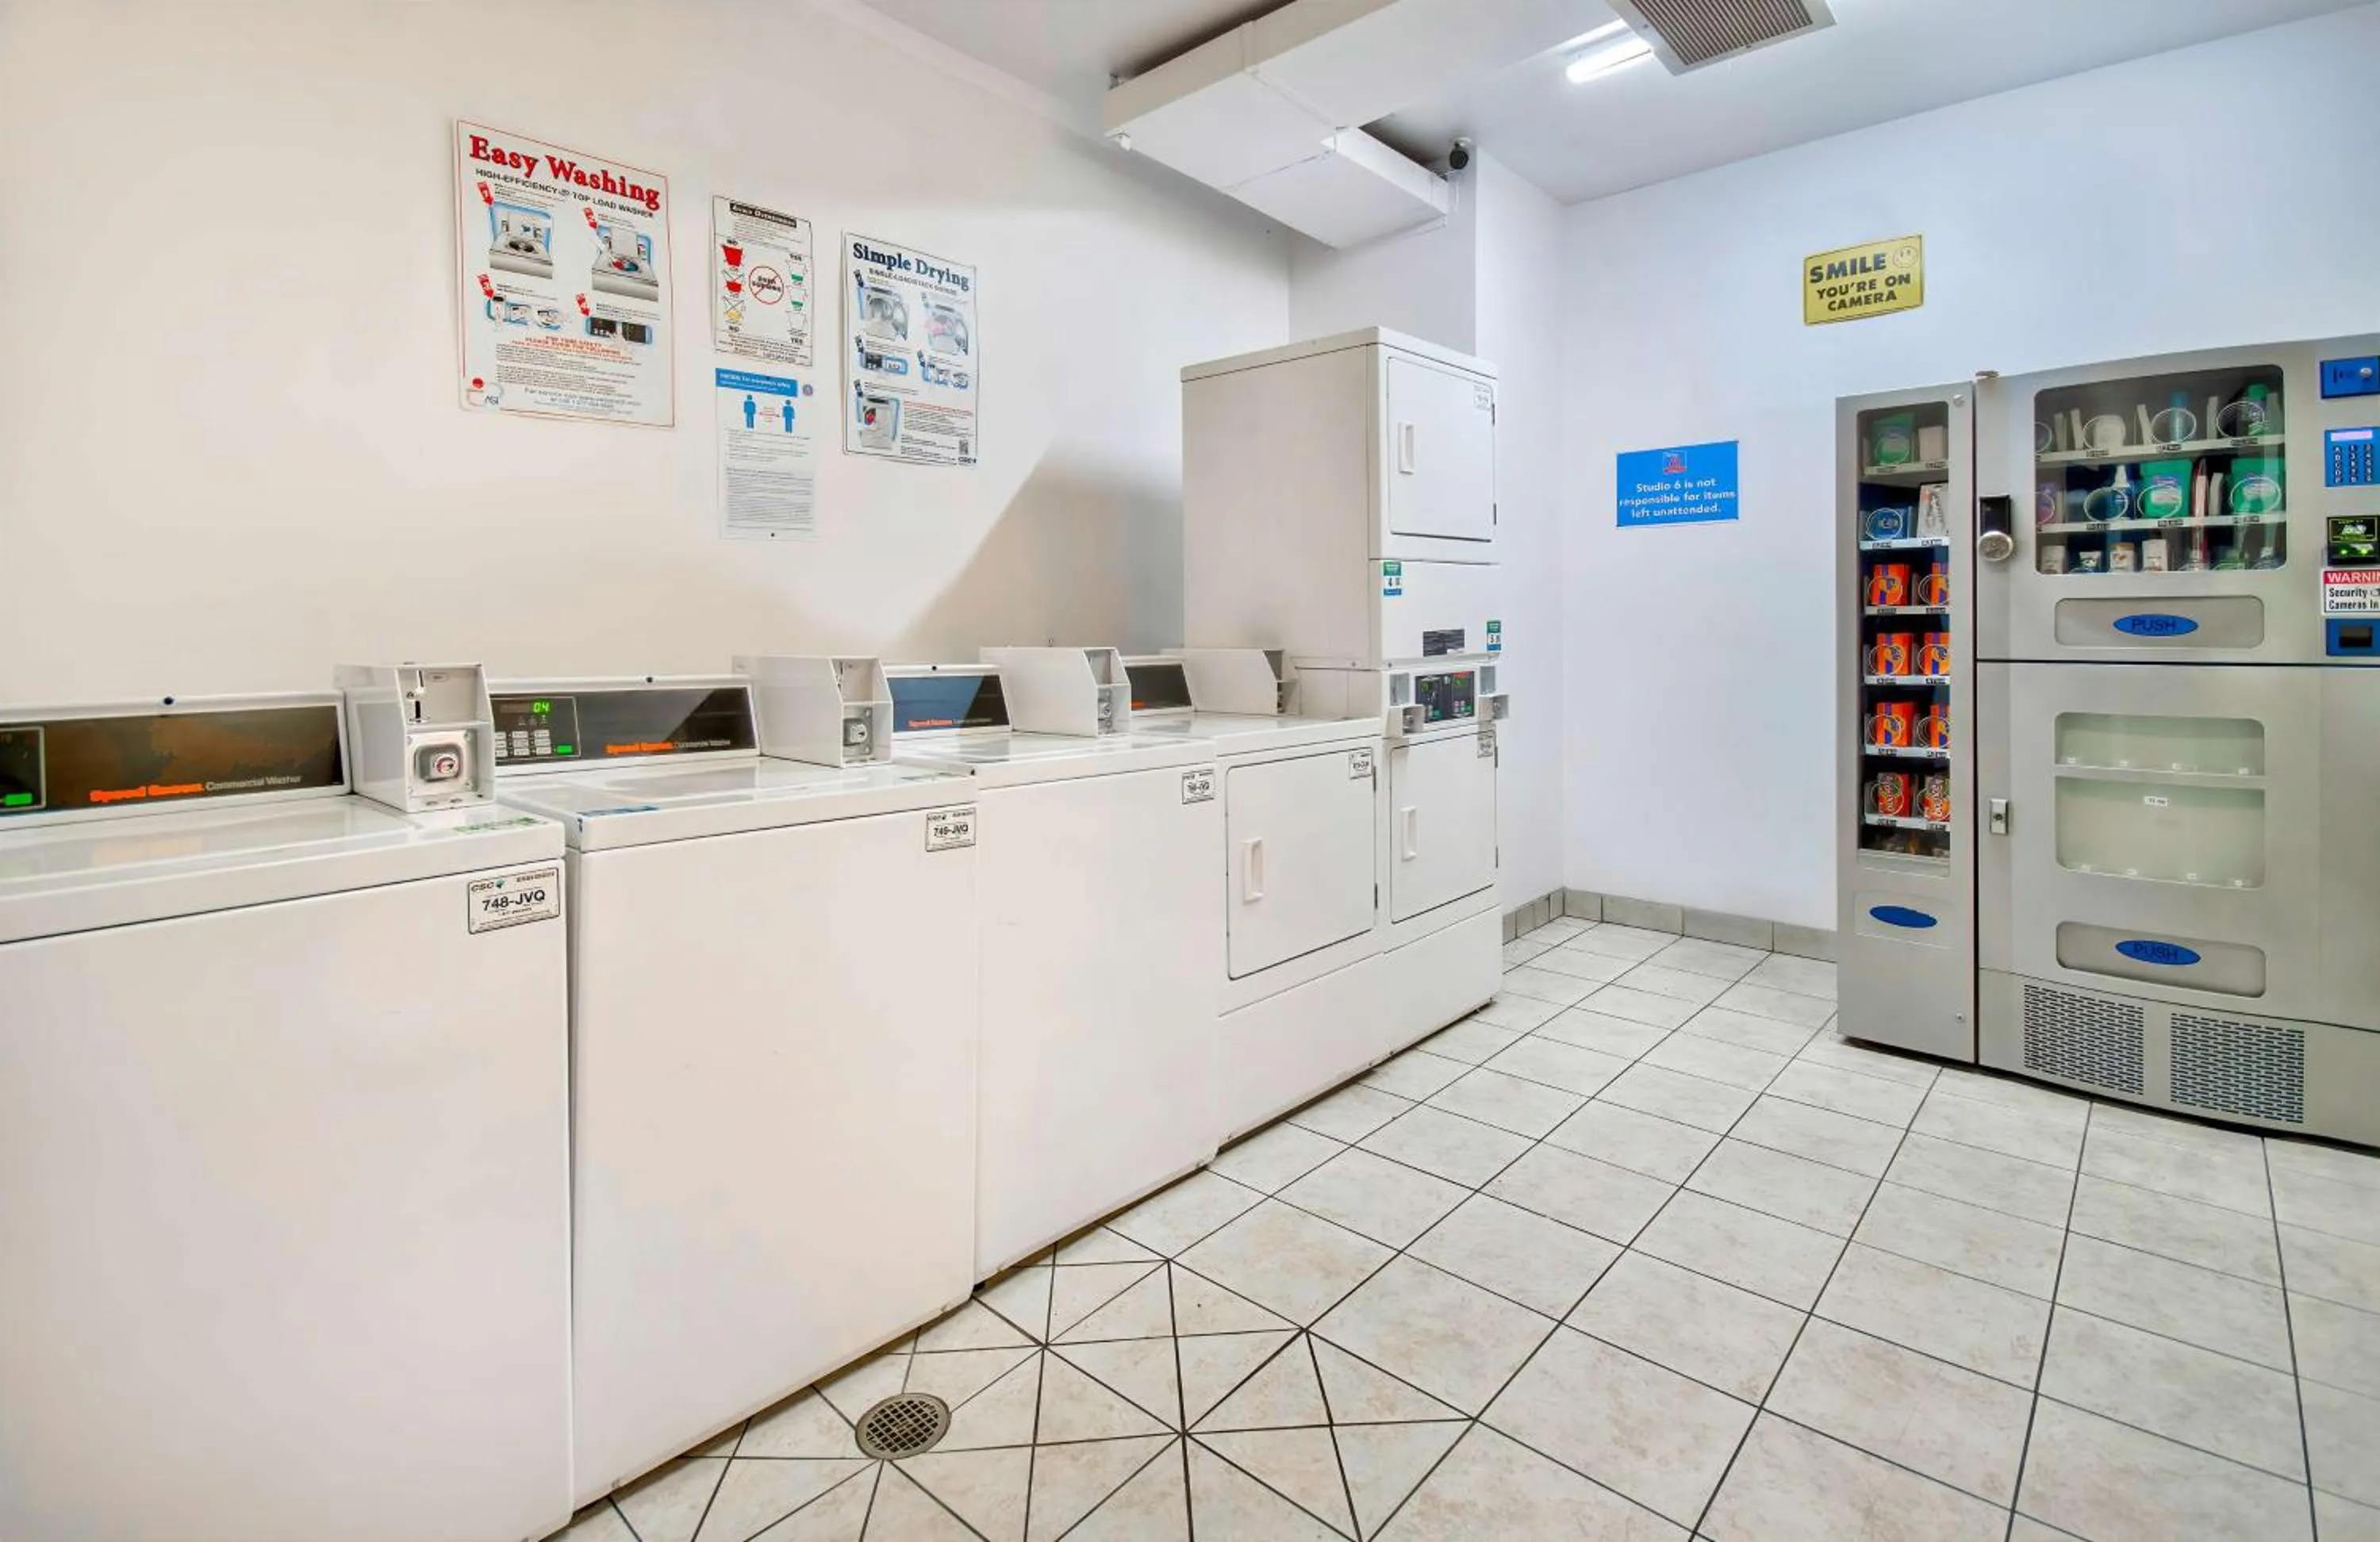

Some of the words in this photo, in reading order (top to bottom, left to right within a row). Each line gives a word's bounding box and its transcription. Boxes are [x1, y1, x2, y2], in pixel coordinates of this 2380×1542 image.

[470, 134, 539, 178] Easy
[545, 155, 660, 210] Washing
[593, 198, 616, 209] LOAD
[853, 242, 912, 270] Simple
[915, 258, 969, 291] Drying
[1810, 253, 1887, 283] SMILE
[1817, 278, 1877, 299] YOU'RE
[1885, 273, 1911, 287] ON
[1827, 290, 1898, 312] CAMERA
[1637, 481, 1672, 493] Studio
[1674, 479, 1682, 489] 6
[1684, 478, 1694, 489] is
[1697, 478, 1717, 488] not
[1619, 493, 1680, 507] responsible
[1683, 492, 1700, 501] for
[1703, 489, 1736, 501] items
[1631, 508, 1651, 518] left
[1653, 503, 1722, 517] unattended.
[2328, 588, 2368, 598] Security
[2328, 599, 2367, 610] Cameras
[2132, 619, 2176, 632] PUSH
[482, 889, 546, 911] 748-JVQ
[2132, 942, 2178, 961] PUSH
